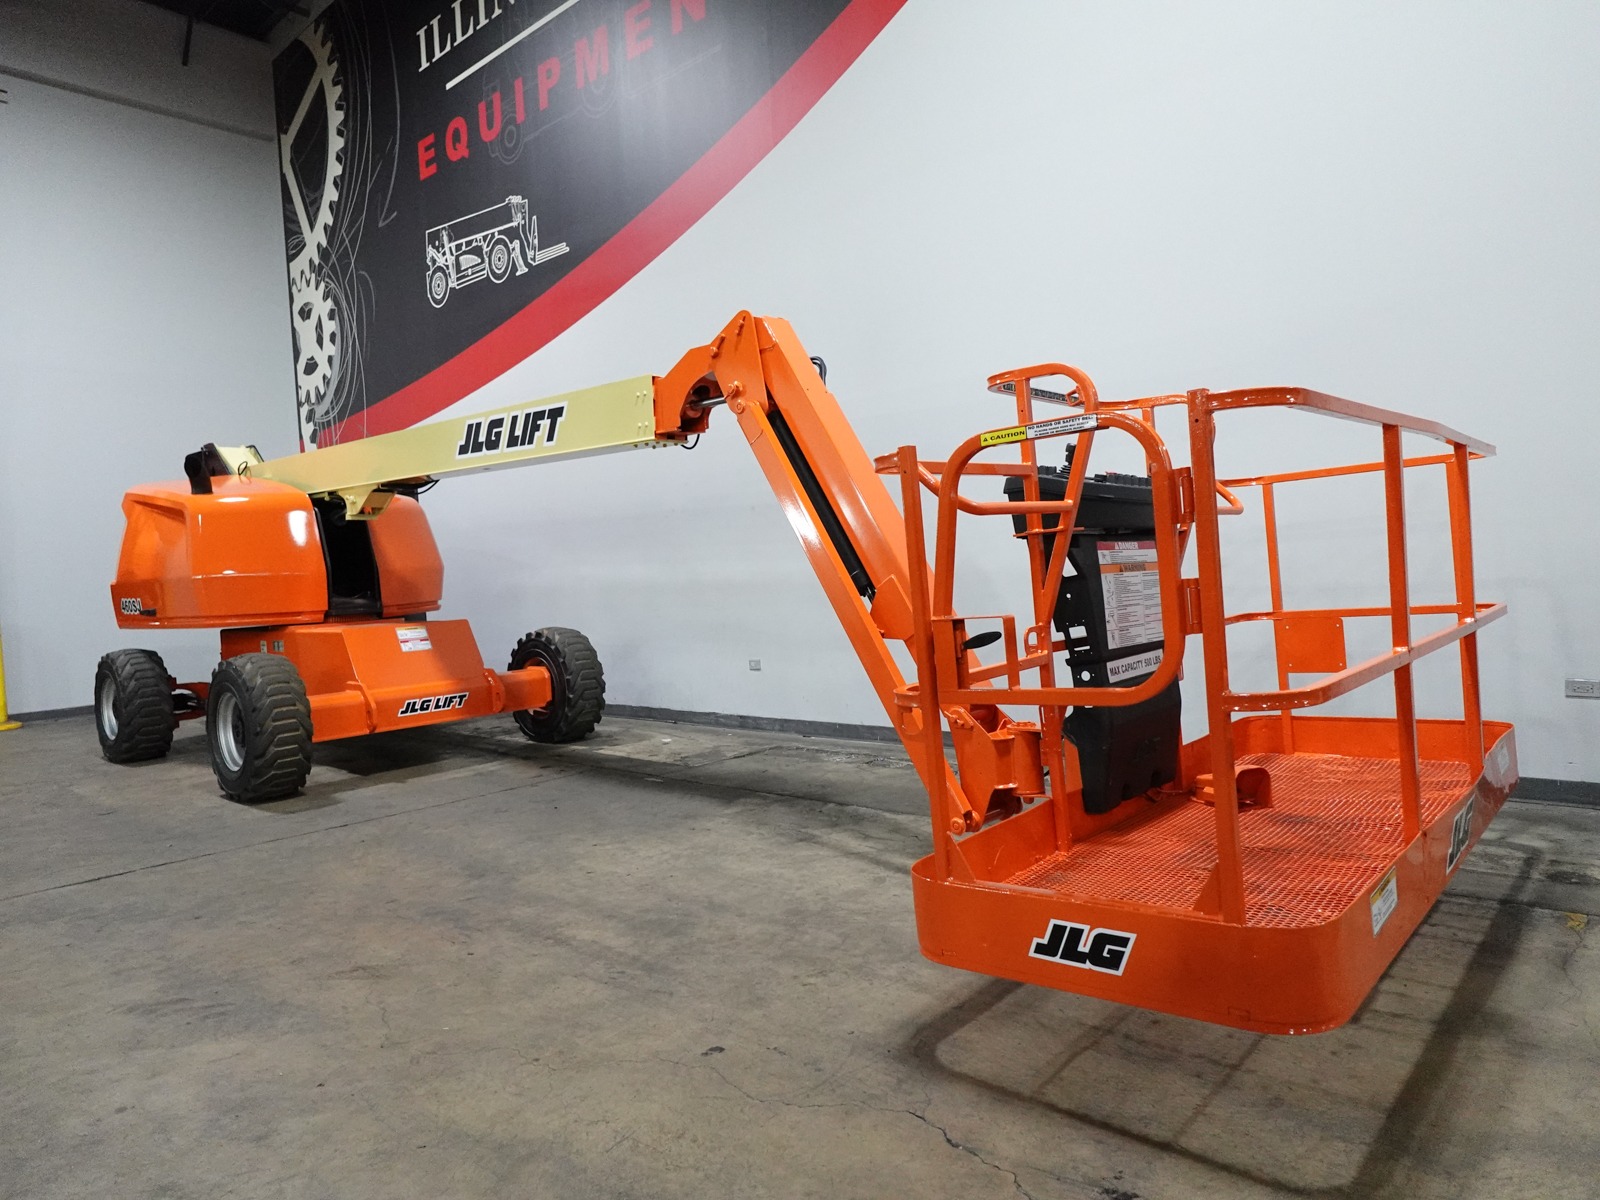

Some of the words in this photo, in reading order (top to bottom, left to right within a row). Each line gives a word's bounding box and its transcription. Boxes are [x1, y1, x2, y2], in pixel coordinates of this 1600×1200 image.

[457, 416, 506, 456] JLG
[505, 405, 565, 449] LIFT
[990, 430, 1025, 441] CAUTION
[1109, 665, 1121, 676] MAX
[1121, 660, 1144, 674] CAPACITY
[399, 698, 433, 715] JLG
[433, 693, 468, 710] LIFT
[1032, 922, 1132, 973] JLG
